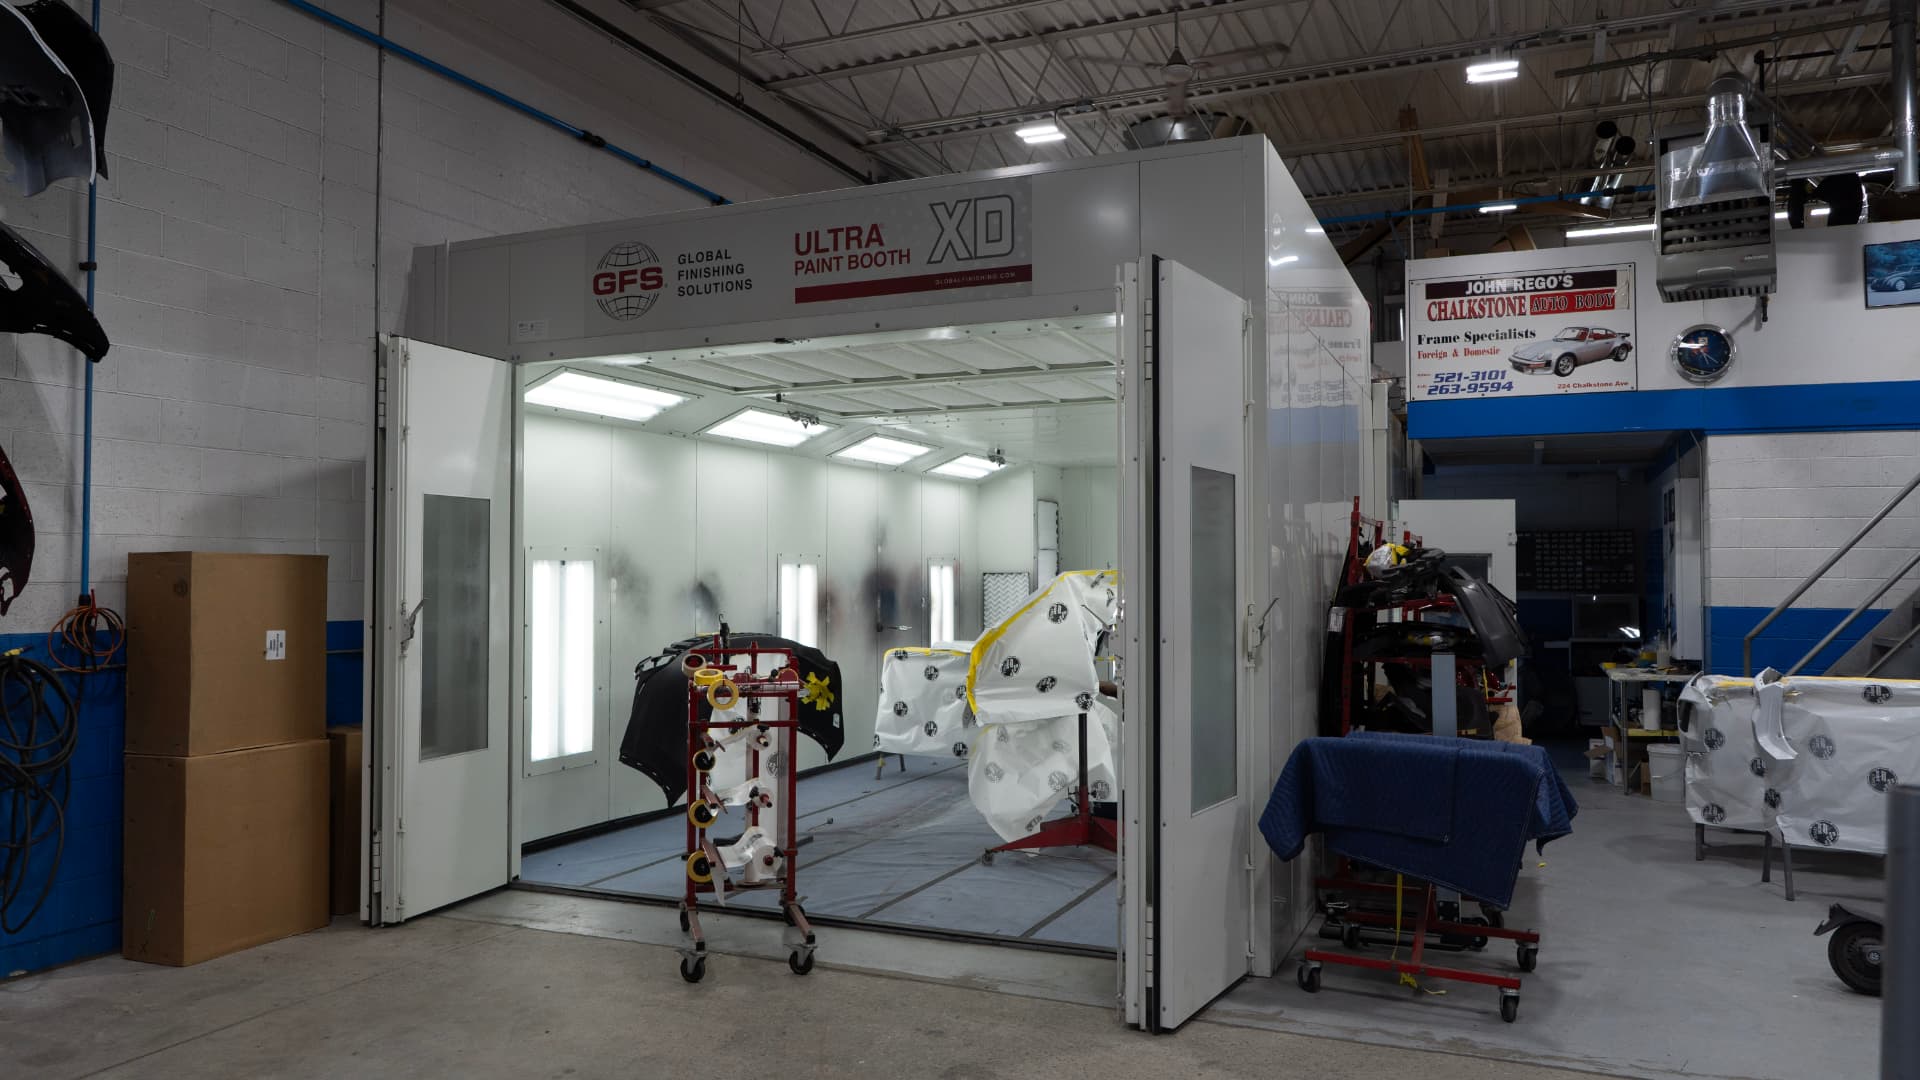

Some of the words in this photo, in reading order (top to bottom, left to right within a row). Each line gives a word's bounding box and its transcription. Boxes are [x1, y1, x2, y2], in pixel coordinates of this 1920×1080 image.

[927, 194, 1015, 265] XD
[794, 223, 885, 257] ULTRA
[677, 248, 732, 265] GLOBAL
[794, 255, 843, 276] PAINT
[848, 248, 911, 269] BOOTH
[677, 263, 745, 281] FINISHING
[592, 266, 664, 297] GFS
[677, 278, 753, 297] SOLUTIONS
[1465, 278, 1508, 295] JOHN
[1513, 274, 1574, 292] REGO'S
[1427, 295, 1526, 321] CHALKSTONE
[1531, 294, 1568, 313] AUTO
[1575, 289, 1615, 308] BODY
[1417, 331, 1460, 345] Frame
[1464, 328, 1536, 344] Specialists
[1417, 349, 1448, 361] Foreign
[1452, 348, 1459, 358] &
[1464, 347, 1500, 357] Domestic
[1433, 369, 1508, 384] 521-3101
[1572, 381, 1614, 389] Chalkstone
[1427, 381, 1514, 396] 263-9594
